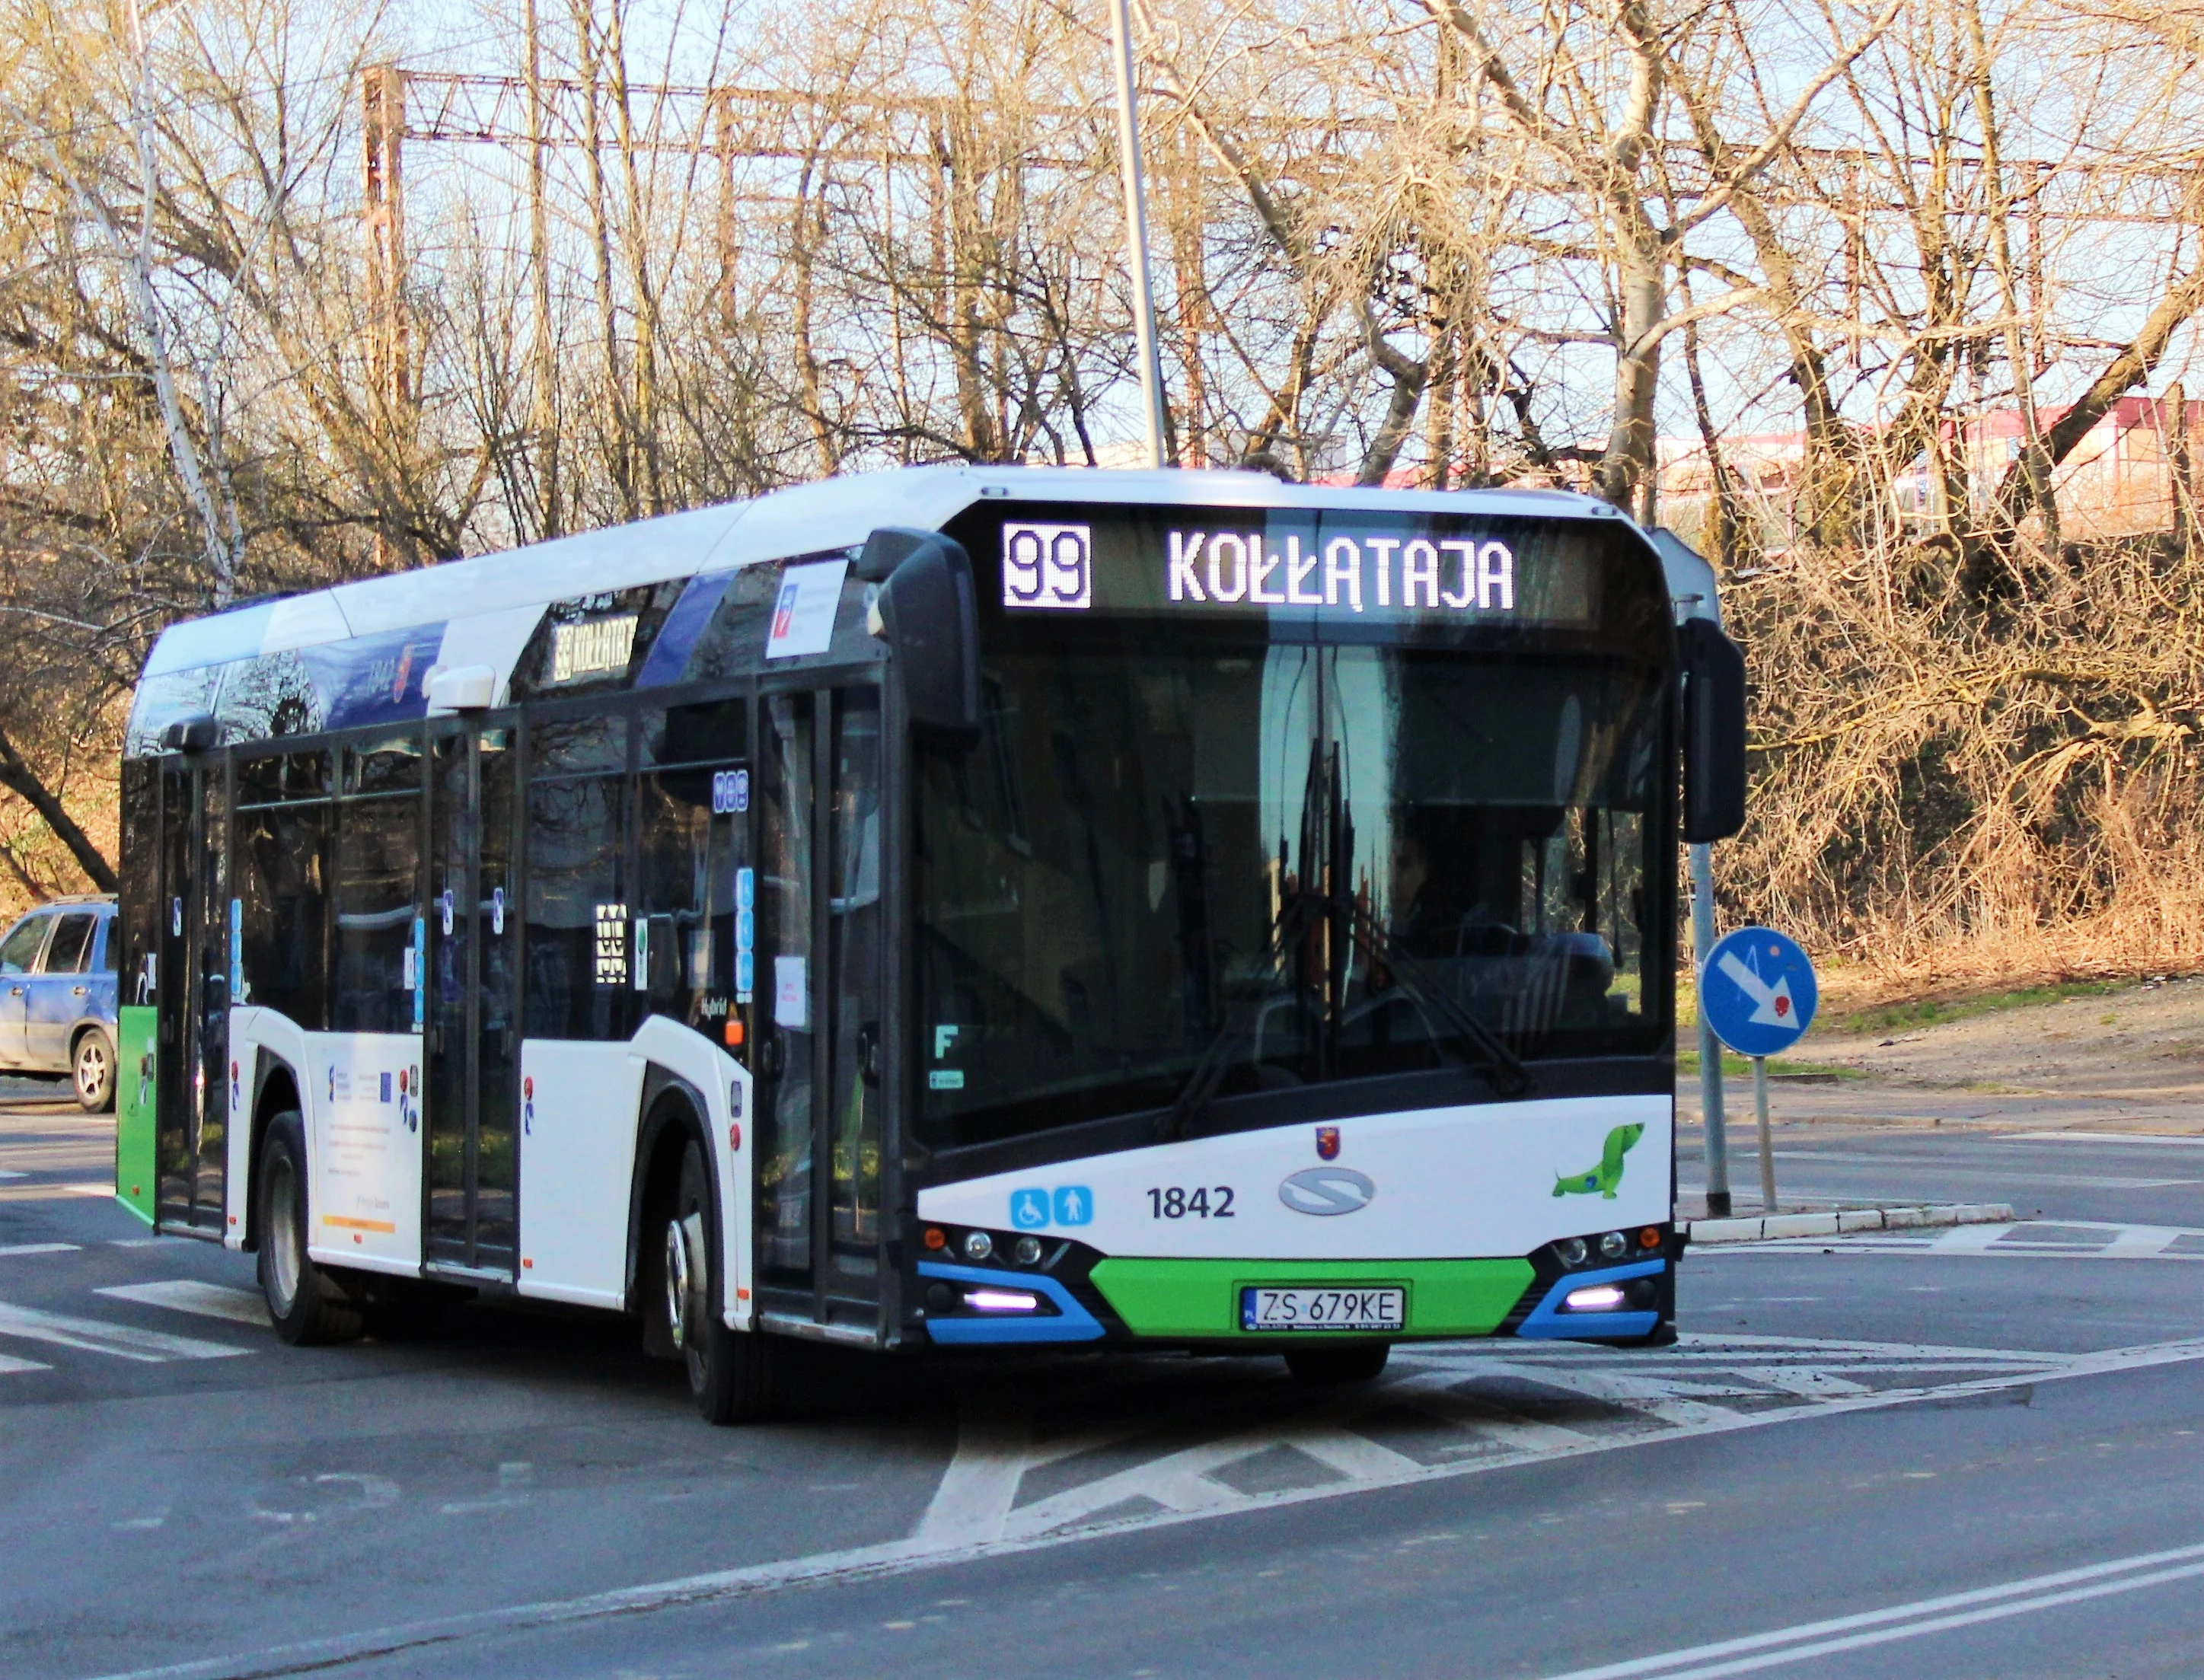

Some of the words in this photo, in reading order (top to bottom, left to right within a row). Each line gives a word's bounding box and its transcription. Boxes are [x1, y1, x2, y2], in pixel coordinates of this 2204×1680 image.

[1007, 529, 1086, 601] 99
[1168, 531, 1514, 613] KOŁŁĄTAJA
[700, 996, 727, 1021] Hybrid
[935, 1025, 958, 1059] F
[1147, 1185, 1236, 1219] 1842
[1263, 1293, 1297, 1321] ZS
[1309, 1293, 1395, 1321] 679KE
